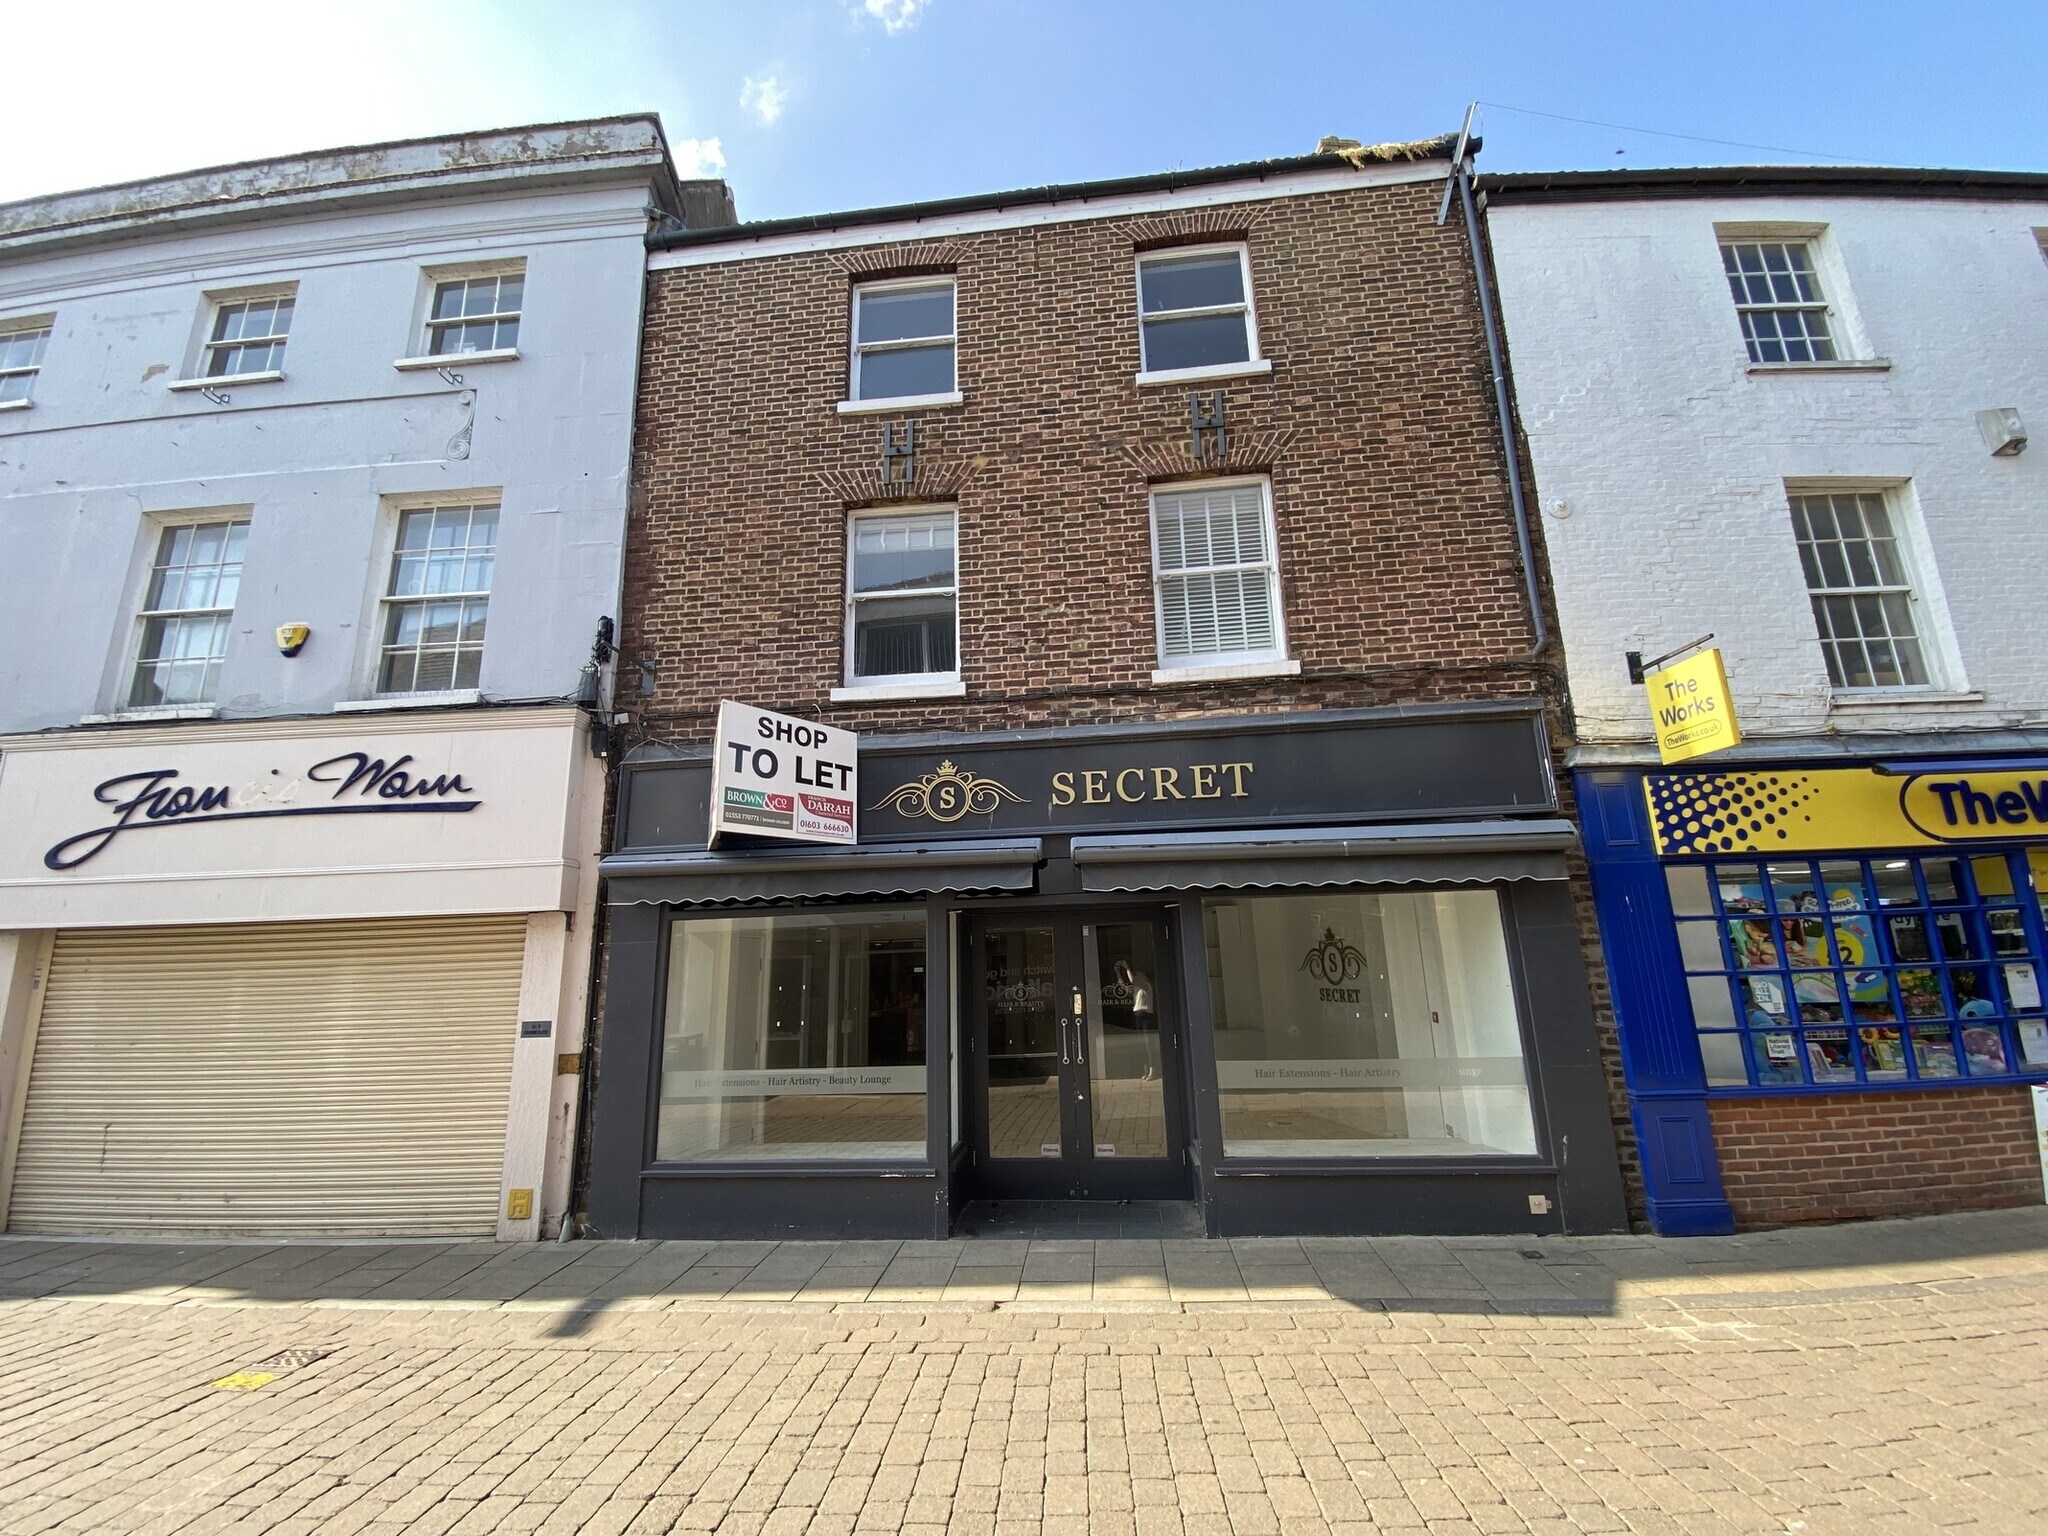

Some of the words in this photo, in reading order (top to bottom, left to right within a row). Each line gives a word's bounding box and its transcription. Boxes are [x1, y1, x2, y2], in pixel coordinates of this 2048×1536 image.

[1664, 678, 1698, 701] The
[1659, 696, 1715, 727] Works
[757, 716, 828, 749] SHOP
[1666, 722, 1719, 746] TheWorks.co.uk
[728, 741, 779, 779] TO
[795, 755, 853, 791] LET
[1051, 762, 1254, 806] SECRET
[807, 800, 851, 815] DARRAH
[939, 786, 956, 809] S
[724, 811, 741, 819] 01553
[800, 819, 821, 829] 01603
[823, 822, 850, 833] 666630
[1328, 952, 1338, 973] S
[997, 1000, 1014, 1008] HAIR
[1319, 987, 1361, 1003] SECRET
[768, 1077, 787, 1086] Hair
[788, 1076, 821, 1087] Artistry
[829, 1075, 858, 1086] Beauty
[860, 1075, 892, 1085] Lounge
[1255, 1068, 1277, 1078] Hair
[1279, 1068, 1331, 1078] Extensions
[1340, 1068, 1362, 1077] Hair
[1363, 1067, 1401, 1079] Artistry
